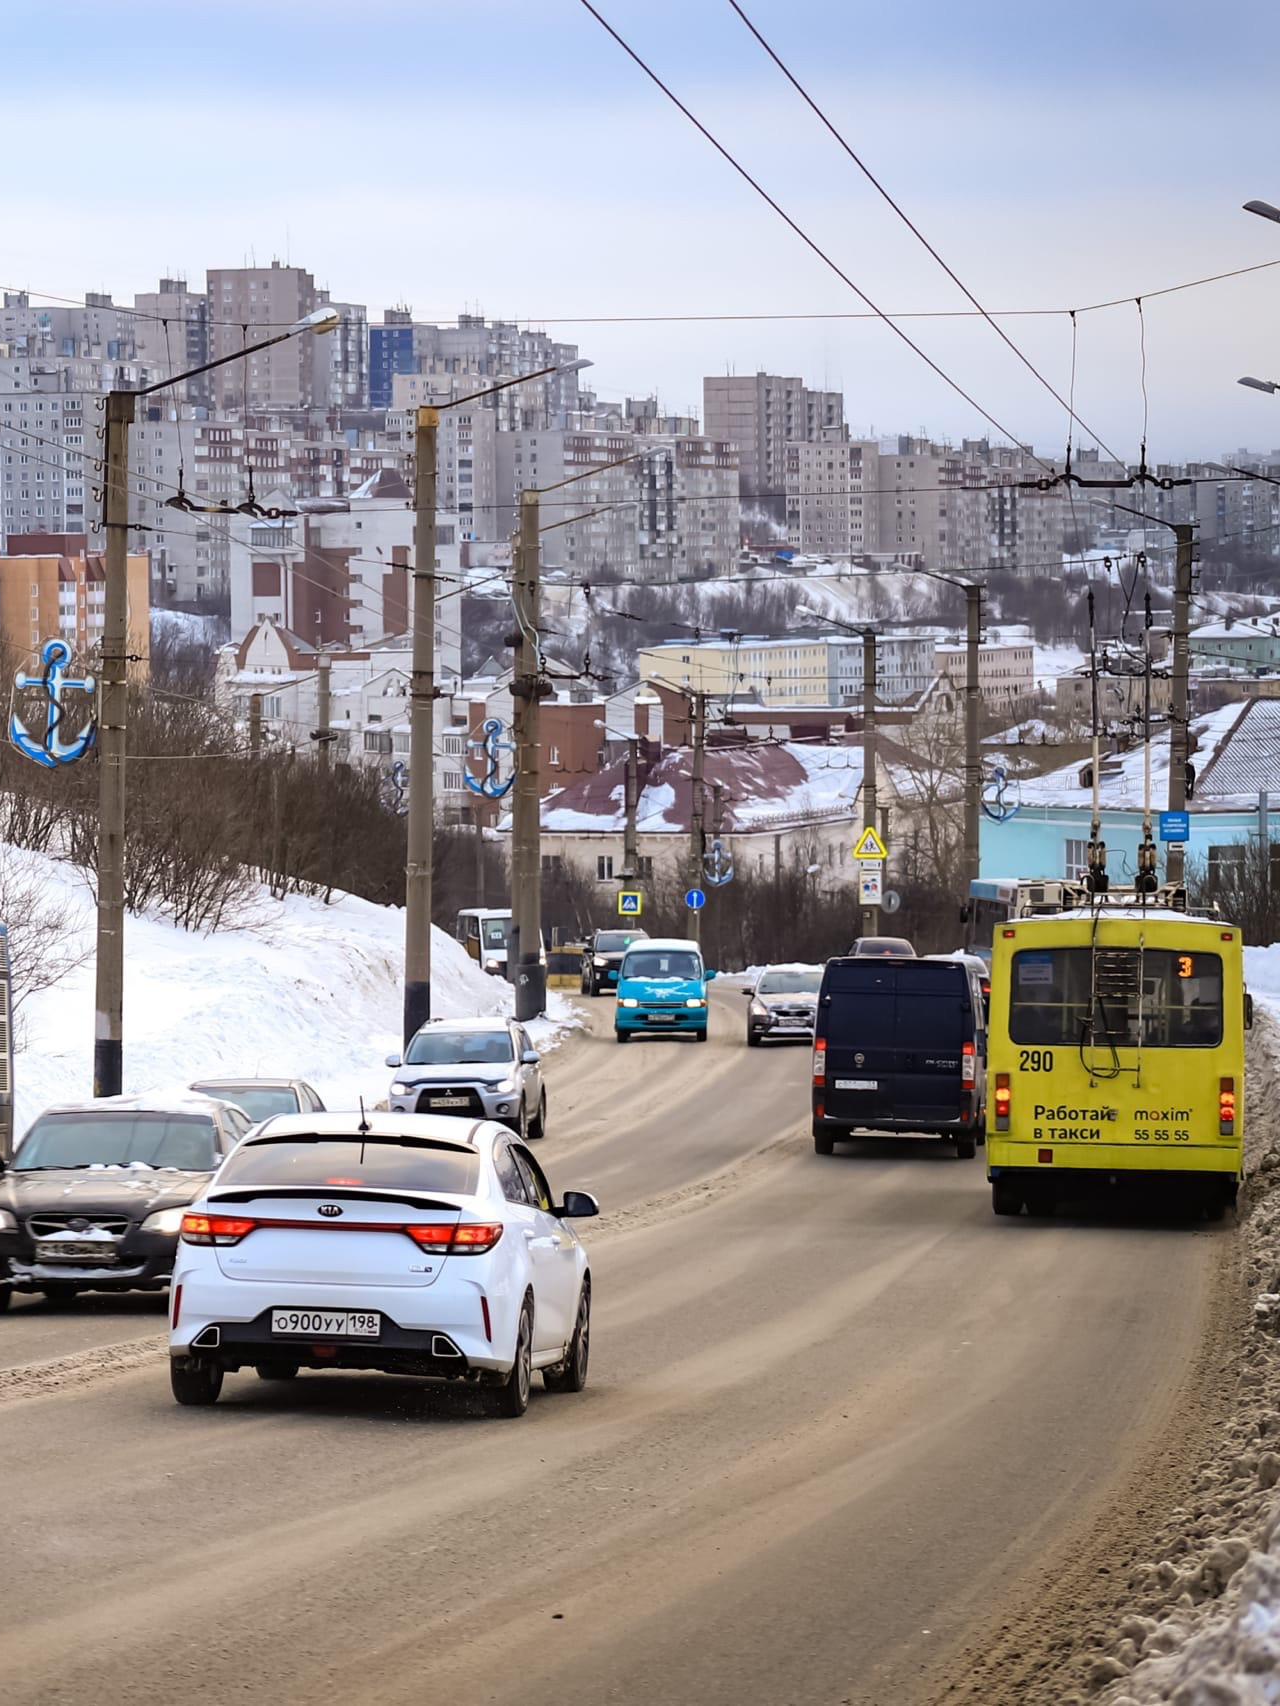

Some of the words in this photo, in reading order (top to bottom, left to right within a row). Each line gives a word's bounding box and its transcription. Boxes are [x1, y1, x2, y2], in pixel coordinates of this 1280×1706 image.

[1177, 956, 1193, 977] 3
[1019, 1050, 1053, 1072] 290
[1033, 1105, 1110, 1121] Работай
[1134, 1108, 1189, 1121] maxim
[1048, 1127, 1100, 1140] такси
[1134, 1129, 1149, 1140] 55
[1154, 1129, 1169, 1140] 55
[1174, 1130, 1189, 1141] 55
[320, 1206, 340, 1215] KIA
